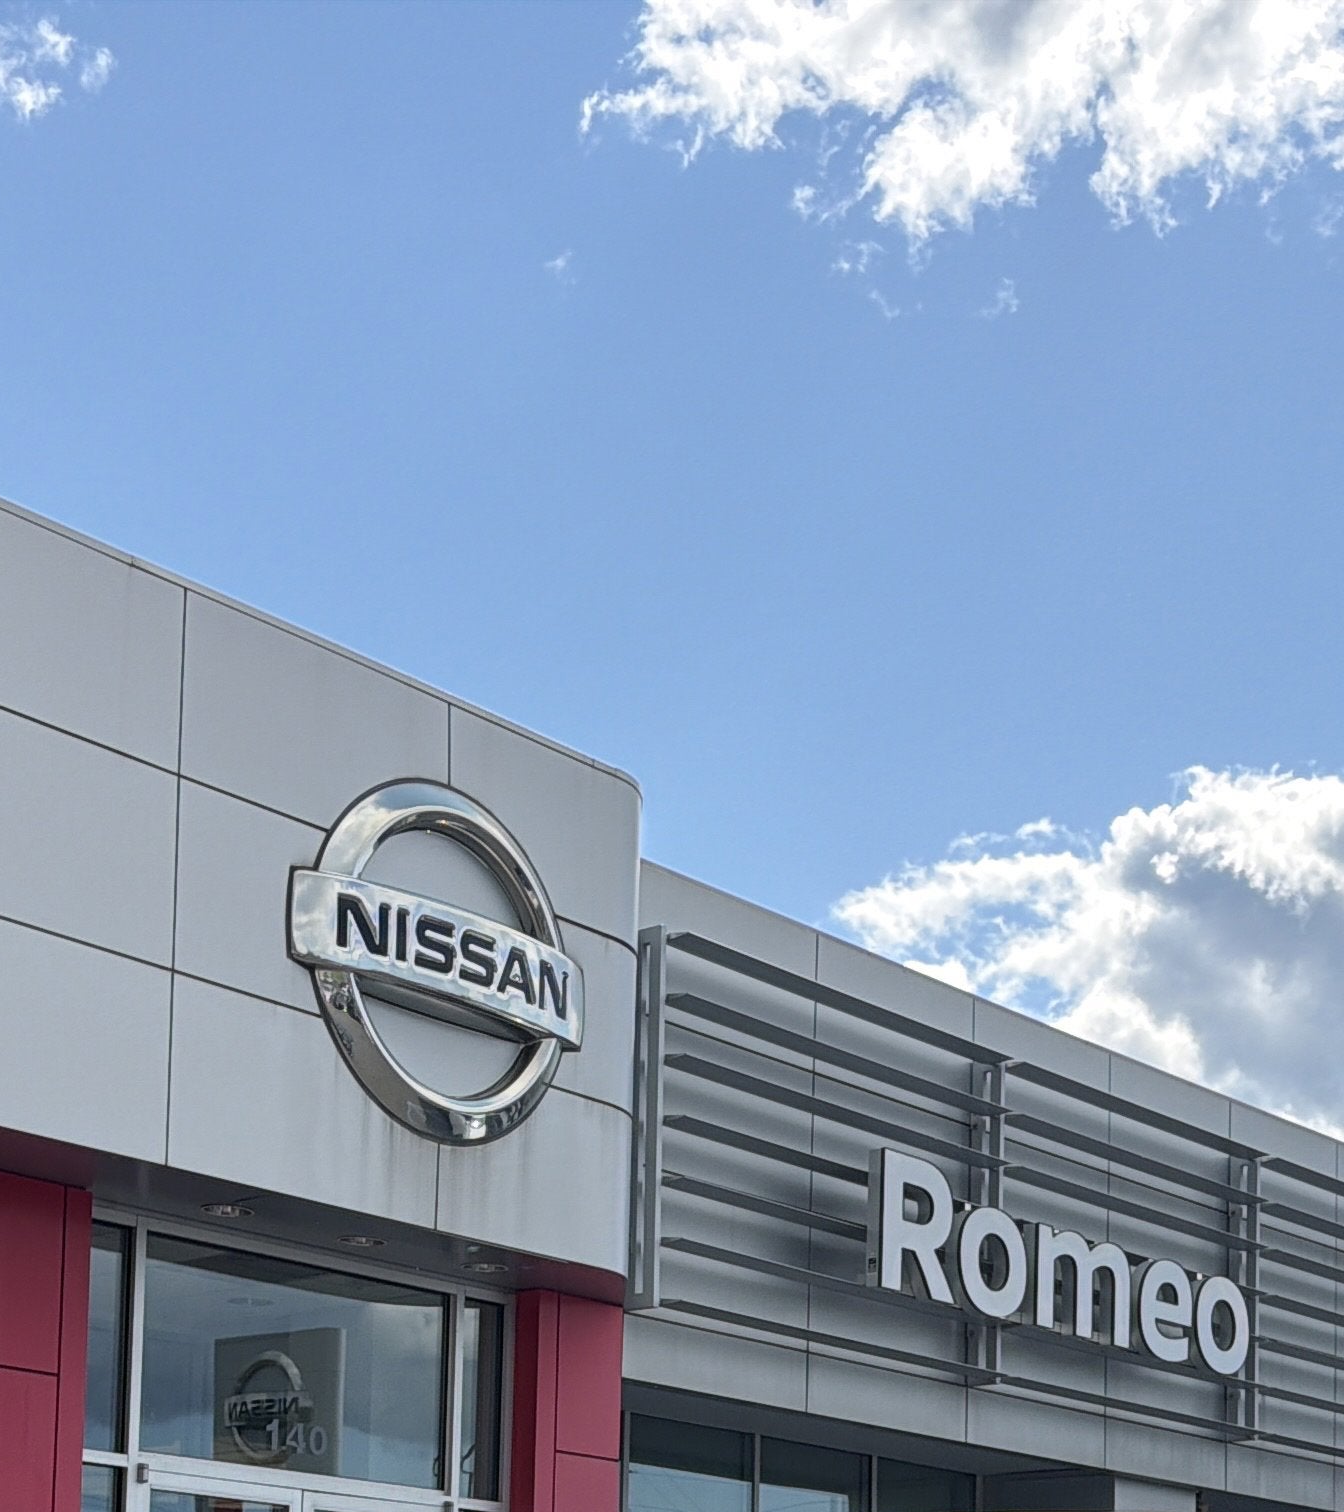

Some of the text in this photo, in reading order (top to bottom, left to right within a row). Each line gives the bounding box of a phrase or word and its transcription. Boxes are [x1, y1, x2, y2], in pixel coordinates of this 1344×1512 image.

[336, 891, 569, 1021] NISSAN
[874, 1147, 1250, 1376] Romeo
[265, 1418, 328, 1456] 140
